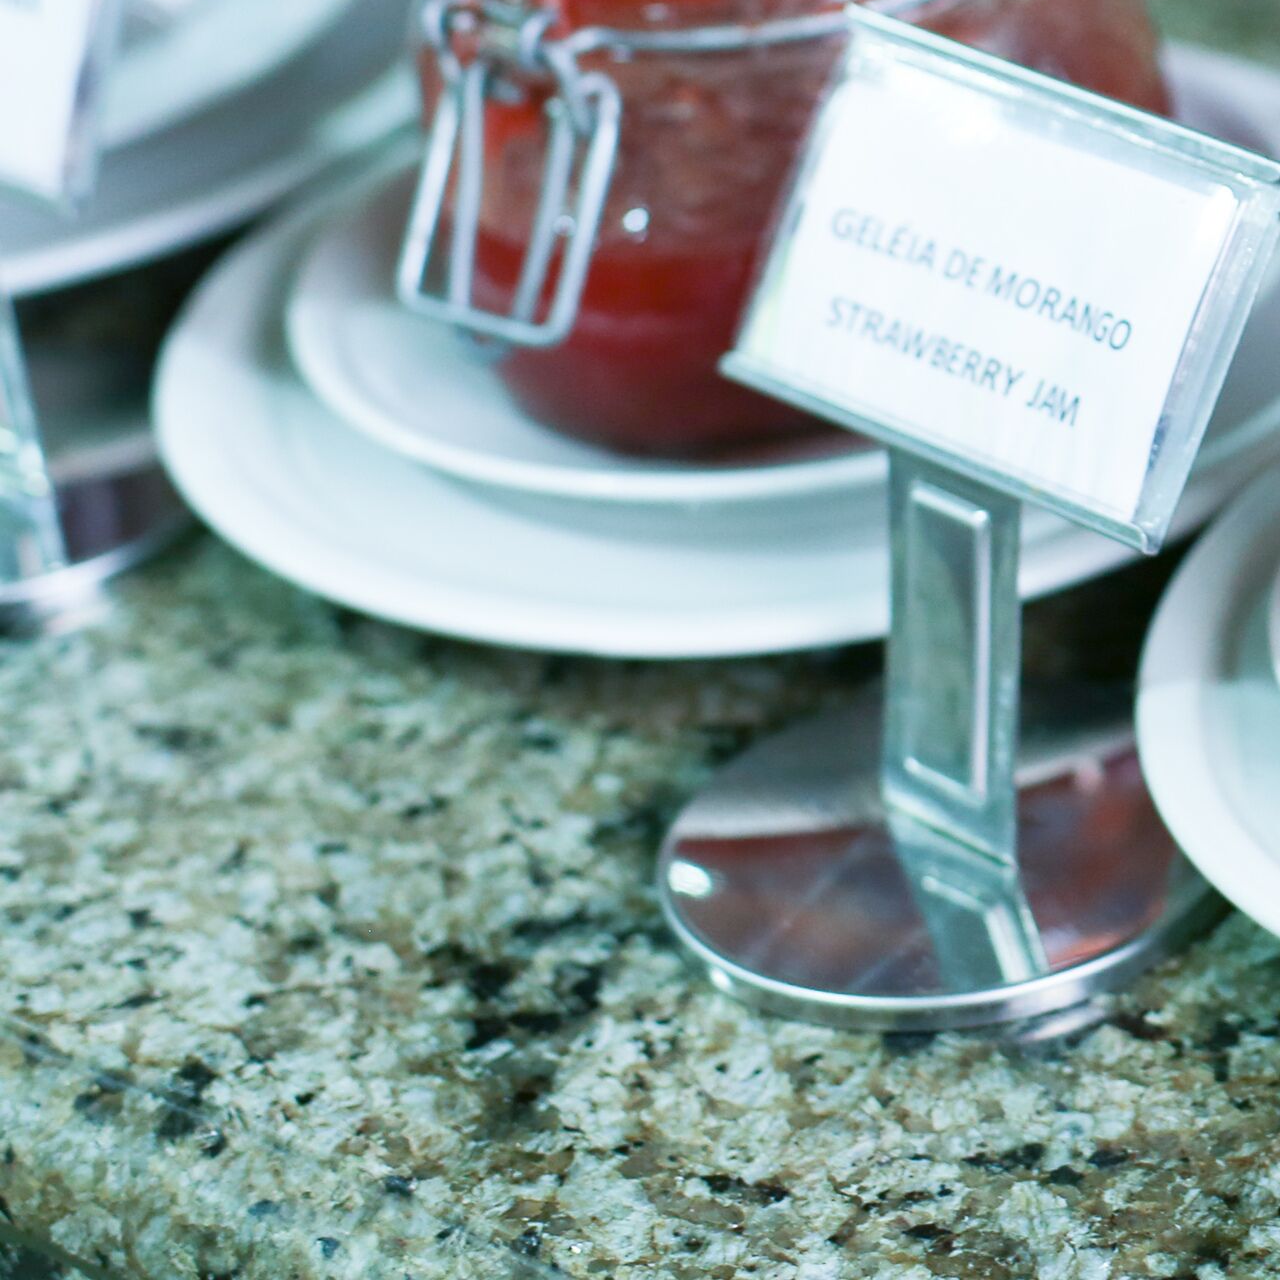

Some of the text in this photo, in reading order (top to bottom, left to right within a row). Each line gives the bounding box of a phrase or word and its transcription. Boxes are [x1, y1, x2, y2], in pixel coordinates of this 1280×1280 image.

[943, 248, 987, 288] DE
[986, 265, 1133, 352] MORANGO
[826, 295, 1082, 428] STRAWBERRY JAM
